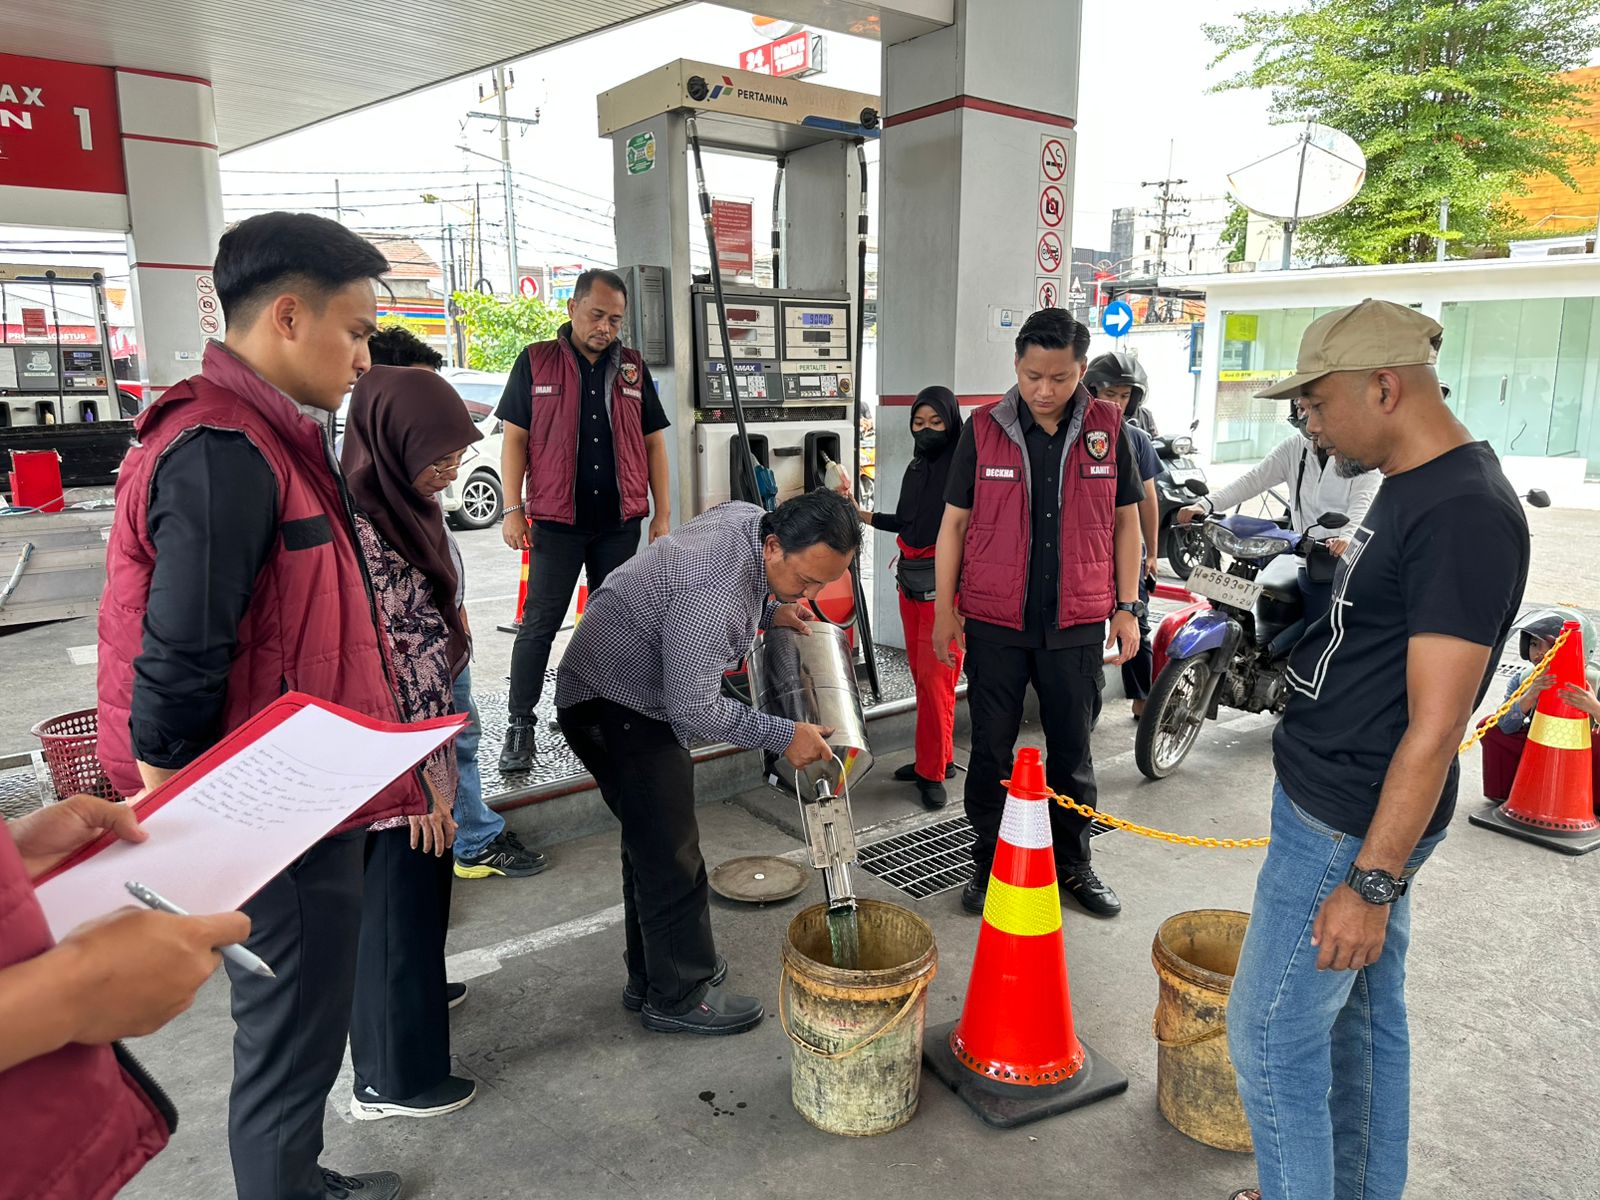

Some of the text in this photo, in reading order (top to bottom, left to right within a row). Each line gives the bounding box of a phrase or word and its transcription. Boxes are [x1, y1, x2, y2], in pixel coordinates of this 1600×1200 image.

[737, 89, 788, 107] PERTAMINA
[73, 107, 93, 150] 1
[716, 363, 755, 371] PEAMAX
[1090, 466, 1110, 475] KANIT
[1207, 572, 1238, 591] 5693
[1242, 583, 1259, 596] TY
